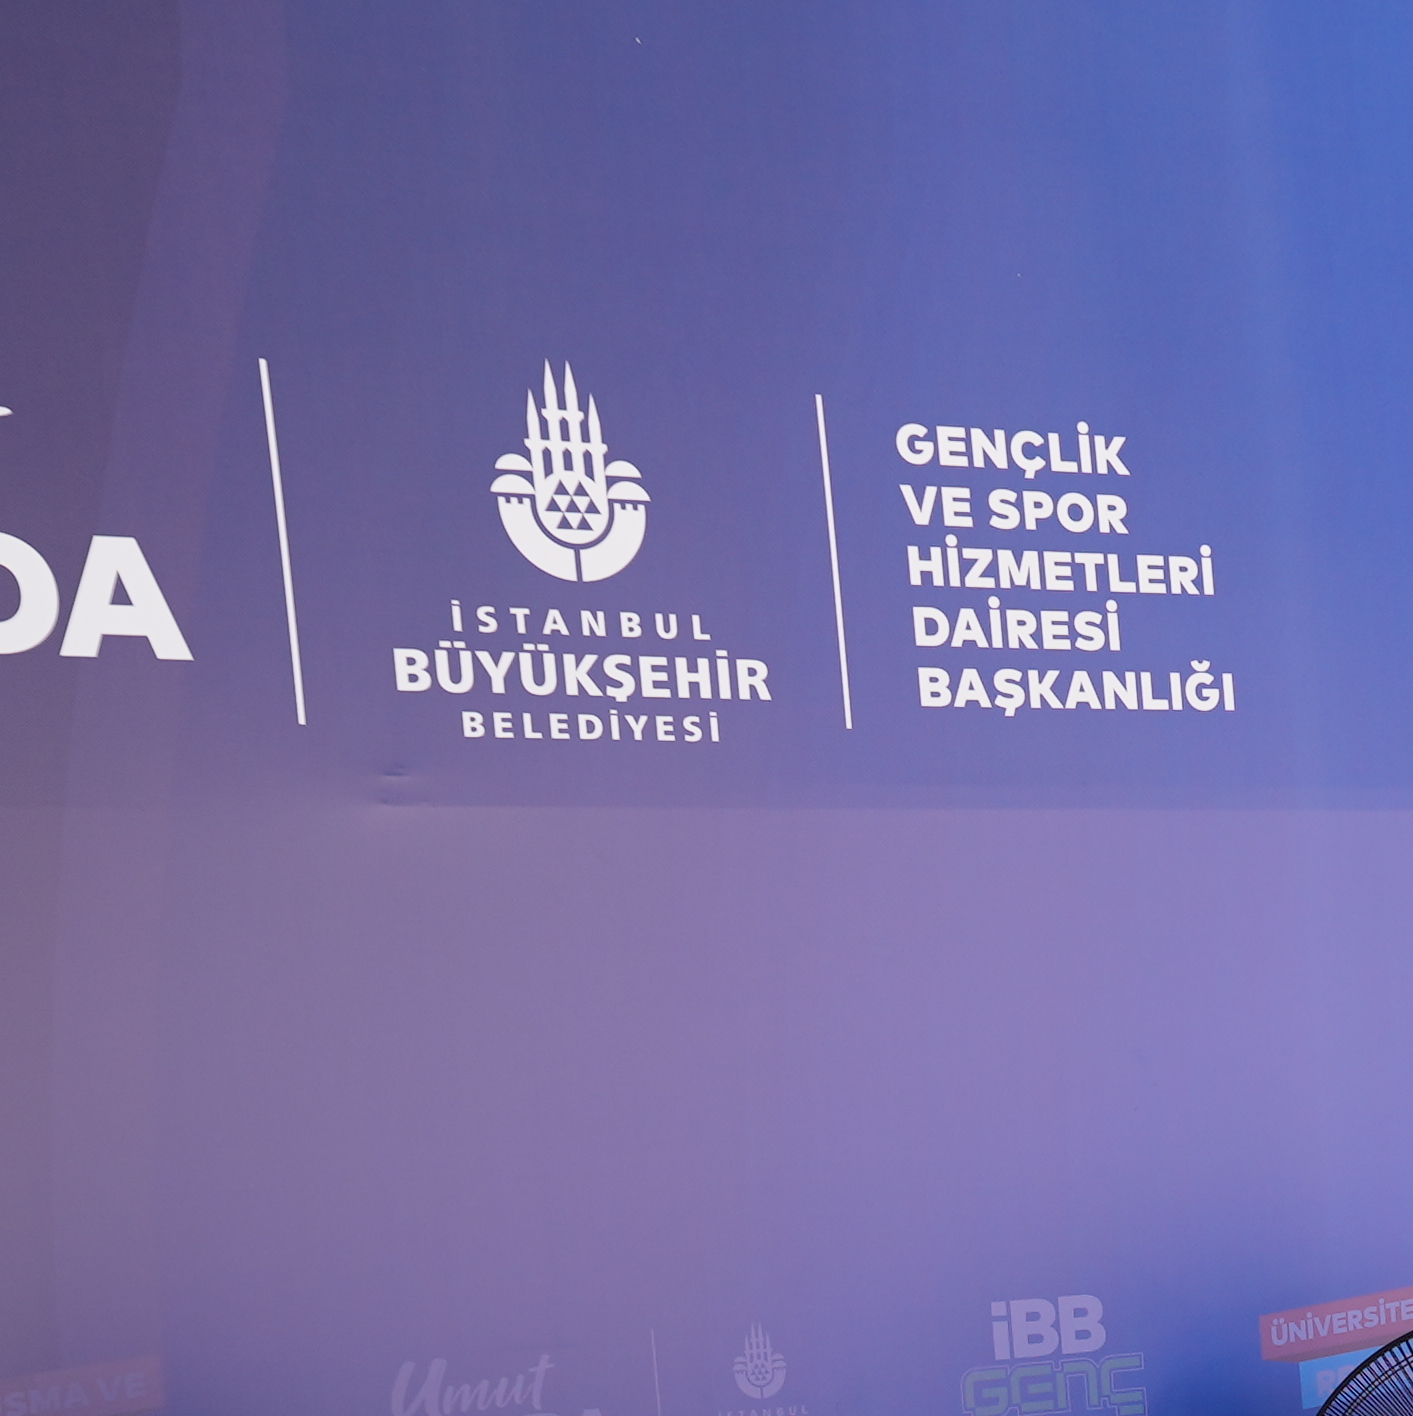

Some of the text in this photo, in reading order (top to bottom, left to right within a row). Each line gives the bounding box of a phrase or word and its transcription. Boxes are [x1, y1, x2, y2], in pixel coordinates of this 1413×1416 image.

[895, 420, 1131, 480] GENÇLİK
[899, 484, 1129, 535] VE SPOR
[907, 533, 1215, 596] HİZMETLERİ
[450, 600, 712, 642] İSTANBUL
[912, 596, 1122, 652] DAİRESİ
[392, 640, 773, 704] BÜYÜKŞEHİR
[917, 659, 1236, 717] BAŞKANLIĞI
[460, 708, 721, 743] BELEDİYESİ
